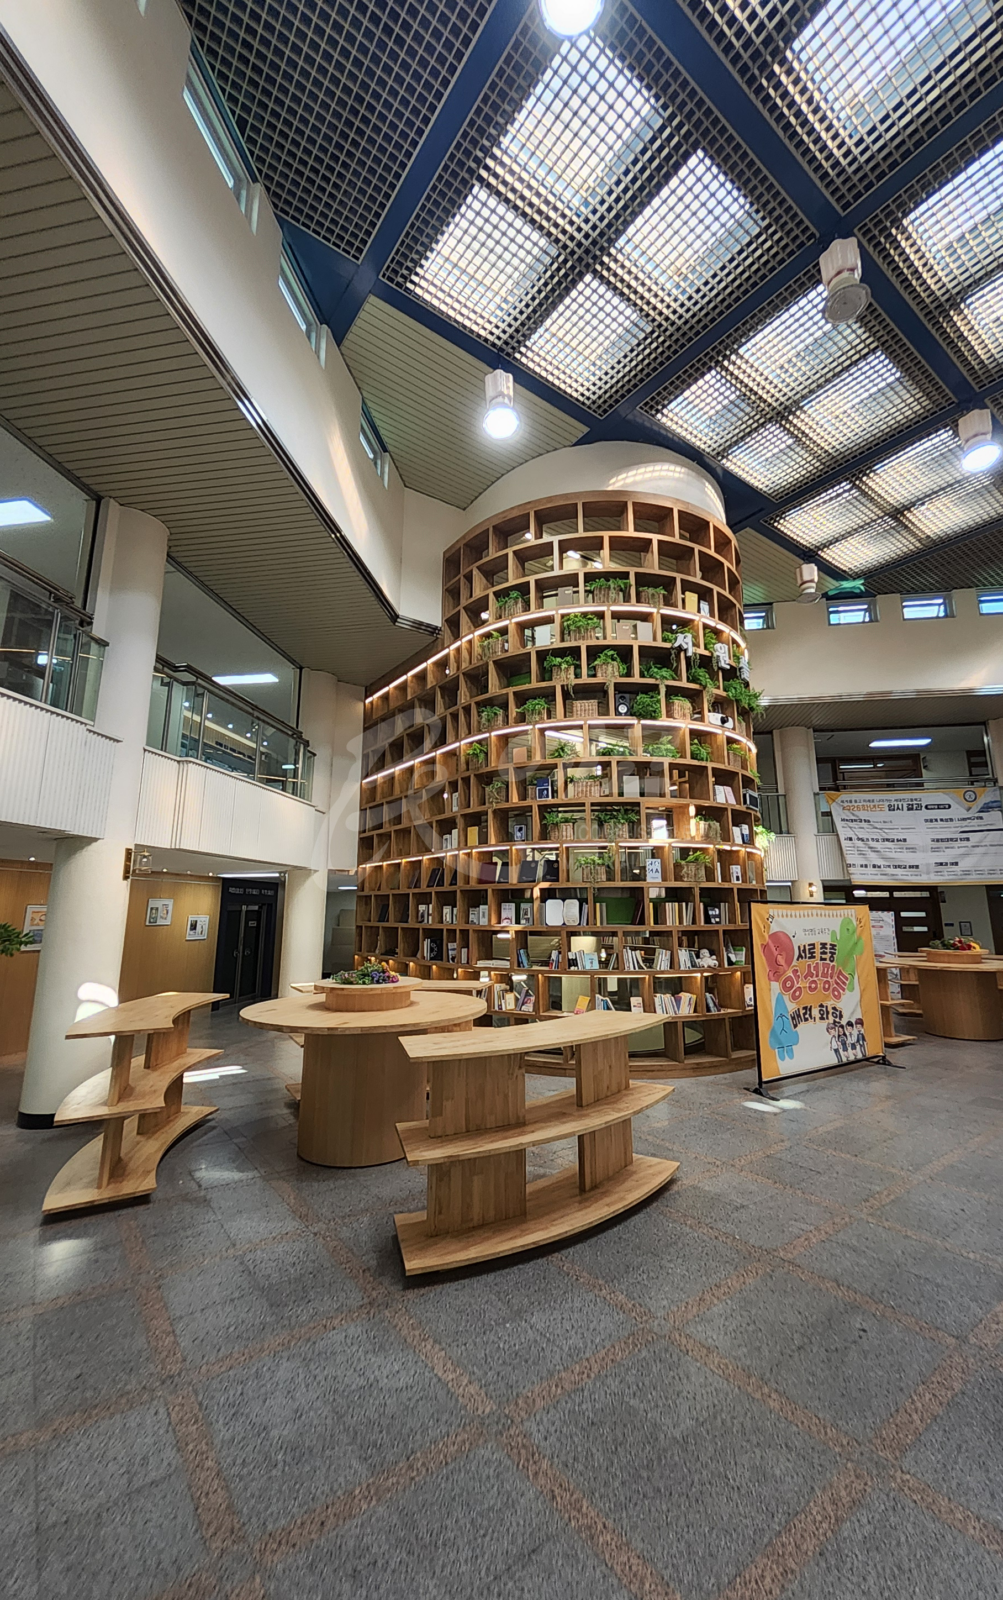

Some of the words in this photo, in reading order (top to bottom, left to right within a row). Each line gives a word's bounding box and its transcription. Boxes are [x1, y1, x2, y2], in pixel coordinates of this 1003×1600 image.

[887, 803, 904, 812] 입시
[906, 803, 923, 812] 결과
[796, 943, 816, 961] 서로
[820, 942, 837, 962] 존중
[781, 962, 849, 1001] 양성평등
[790, 1005, 816, 1029] 배려,
